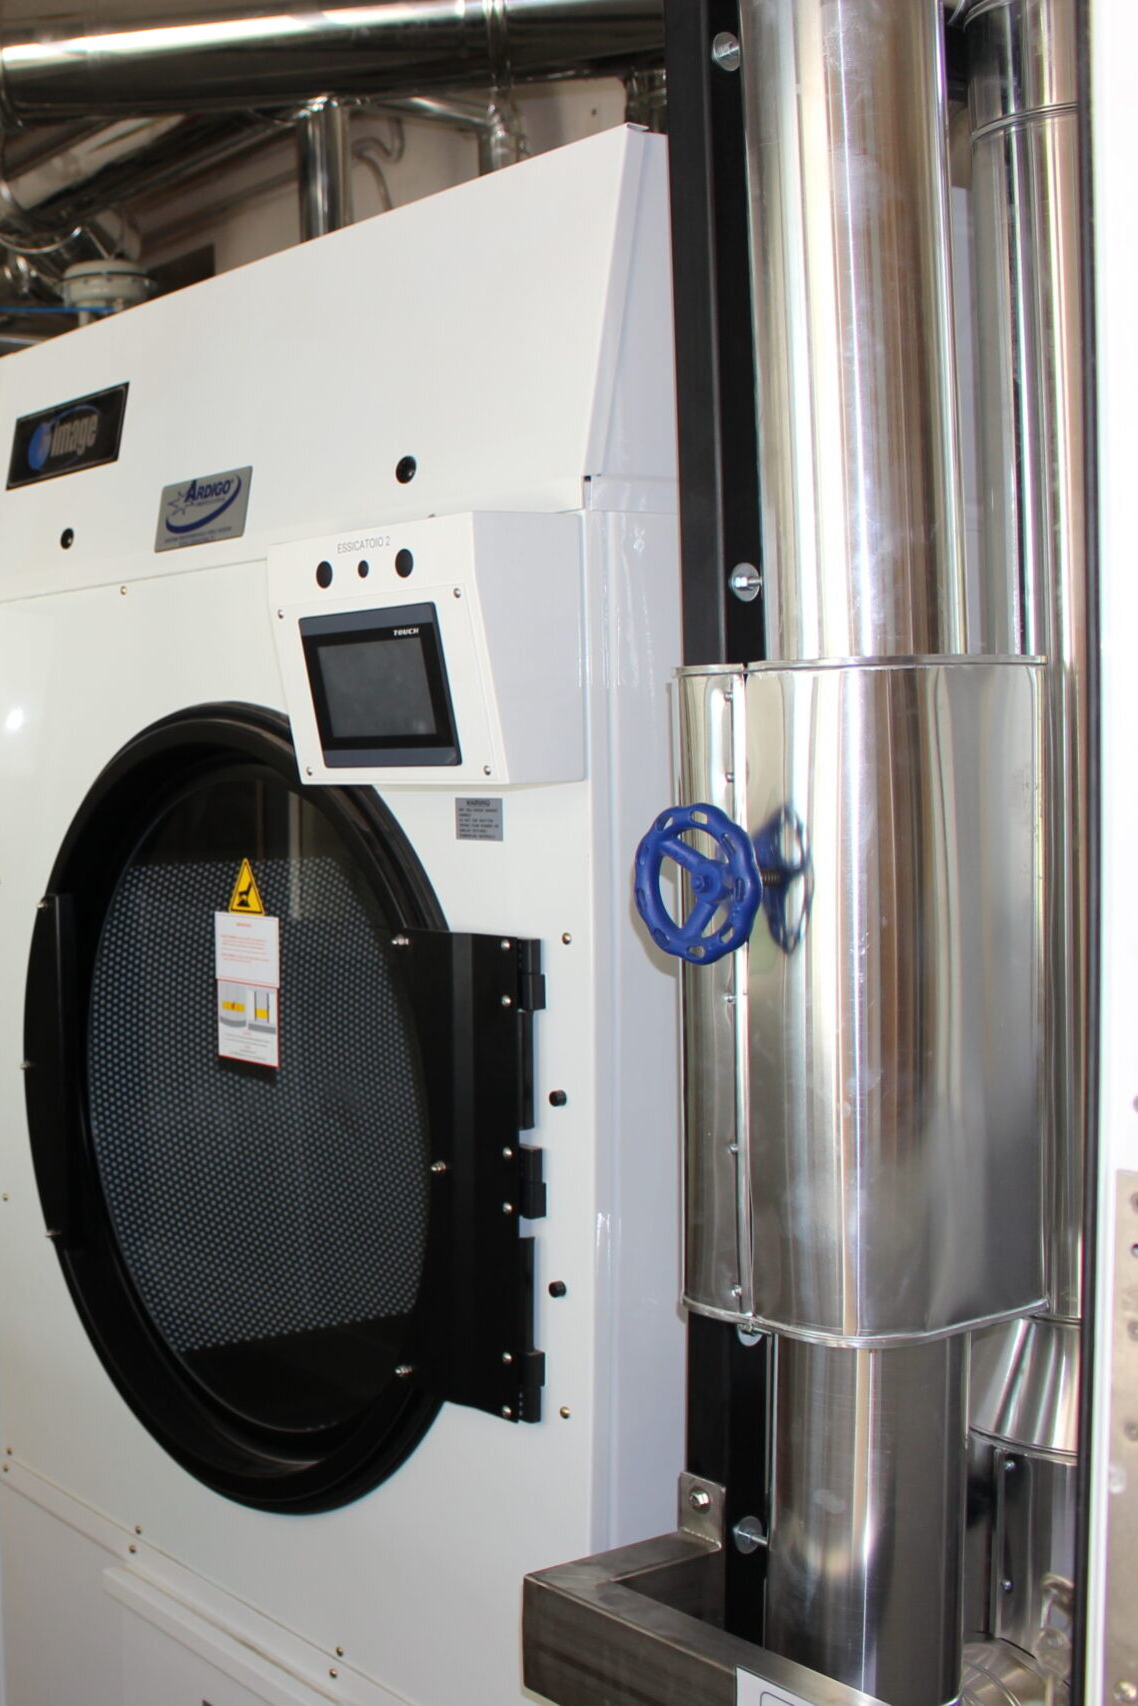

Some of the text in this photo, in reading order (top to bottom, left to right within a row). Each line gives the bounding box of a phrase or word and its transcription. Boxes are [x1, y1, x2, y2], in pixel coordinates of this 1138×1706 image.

[337, 535, 391, 555] ESSICATOIO 2
[393, 627, 419, 637] TOUCH
